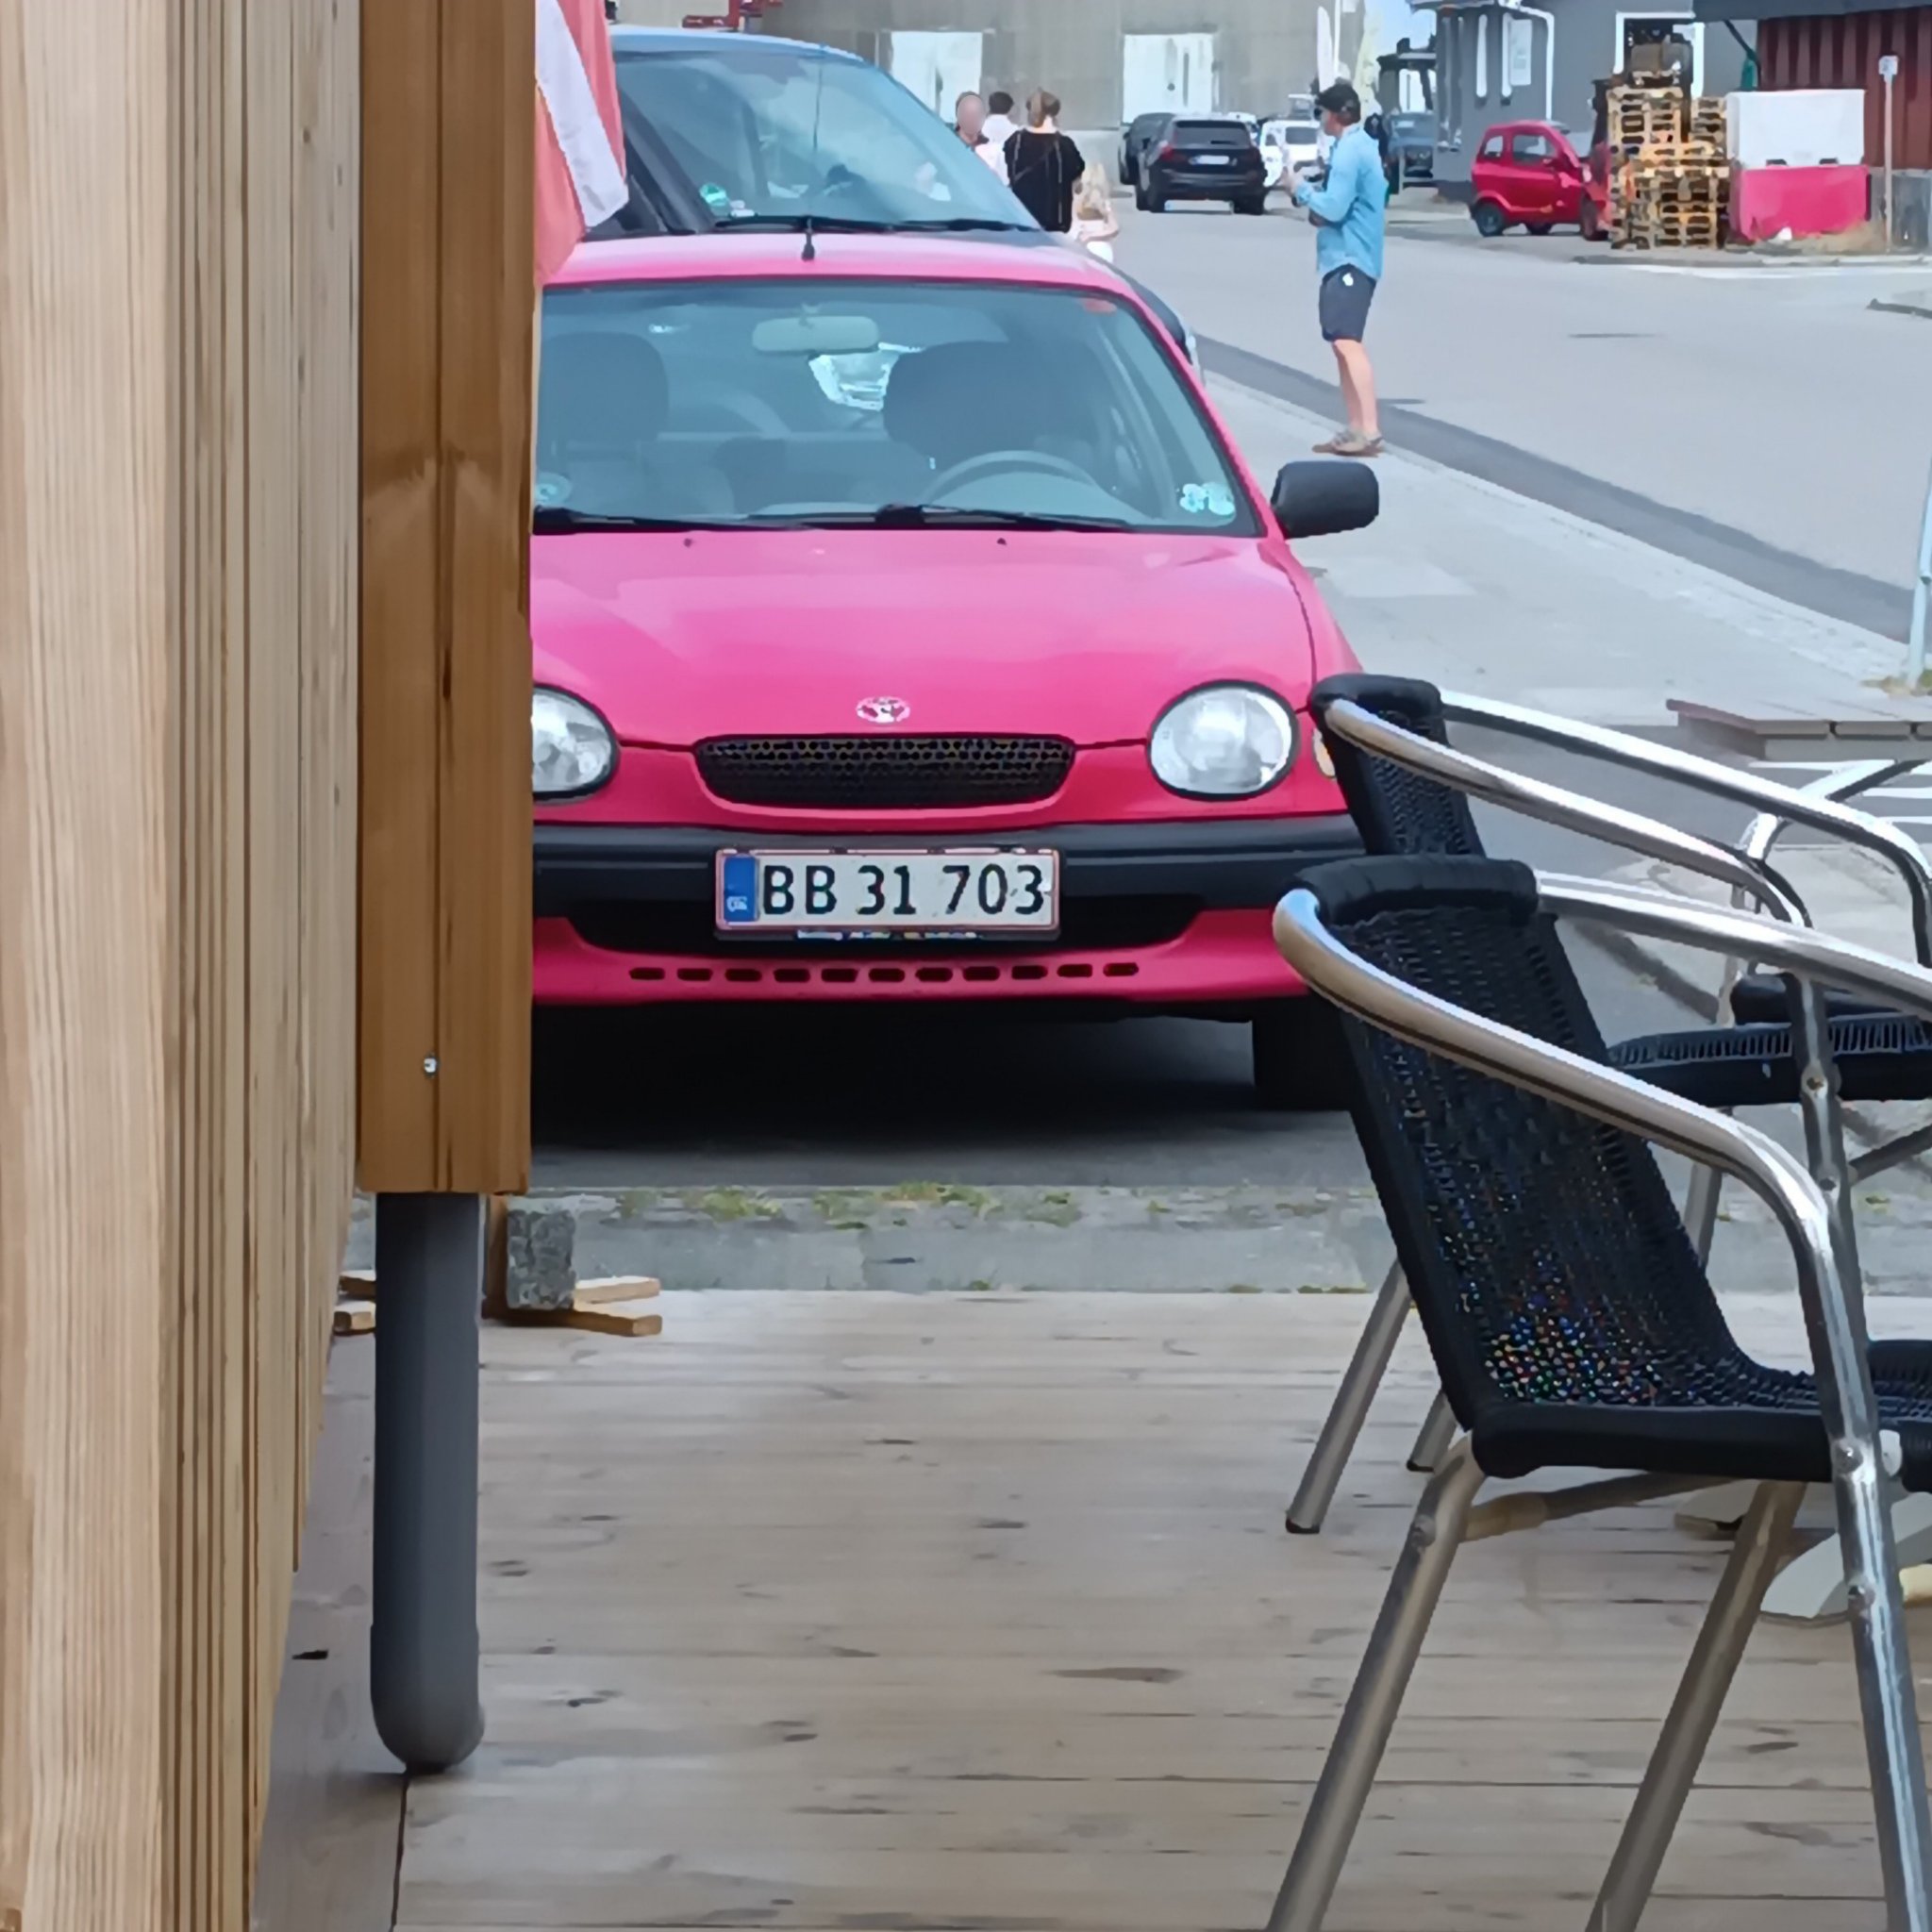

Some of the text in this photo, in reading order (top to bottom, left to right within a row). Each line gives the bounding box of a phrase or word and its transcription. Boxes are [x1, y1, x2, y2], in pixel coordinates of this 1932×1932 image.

[763, 863, 1044, 915] BB 31 703
